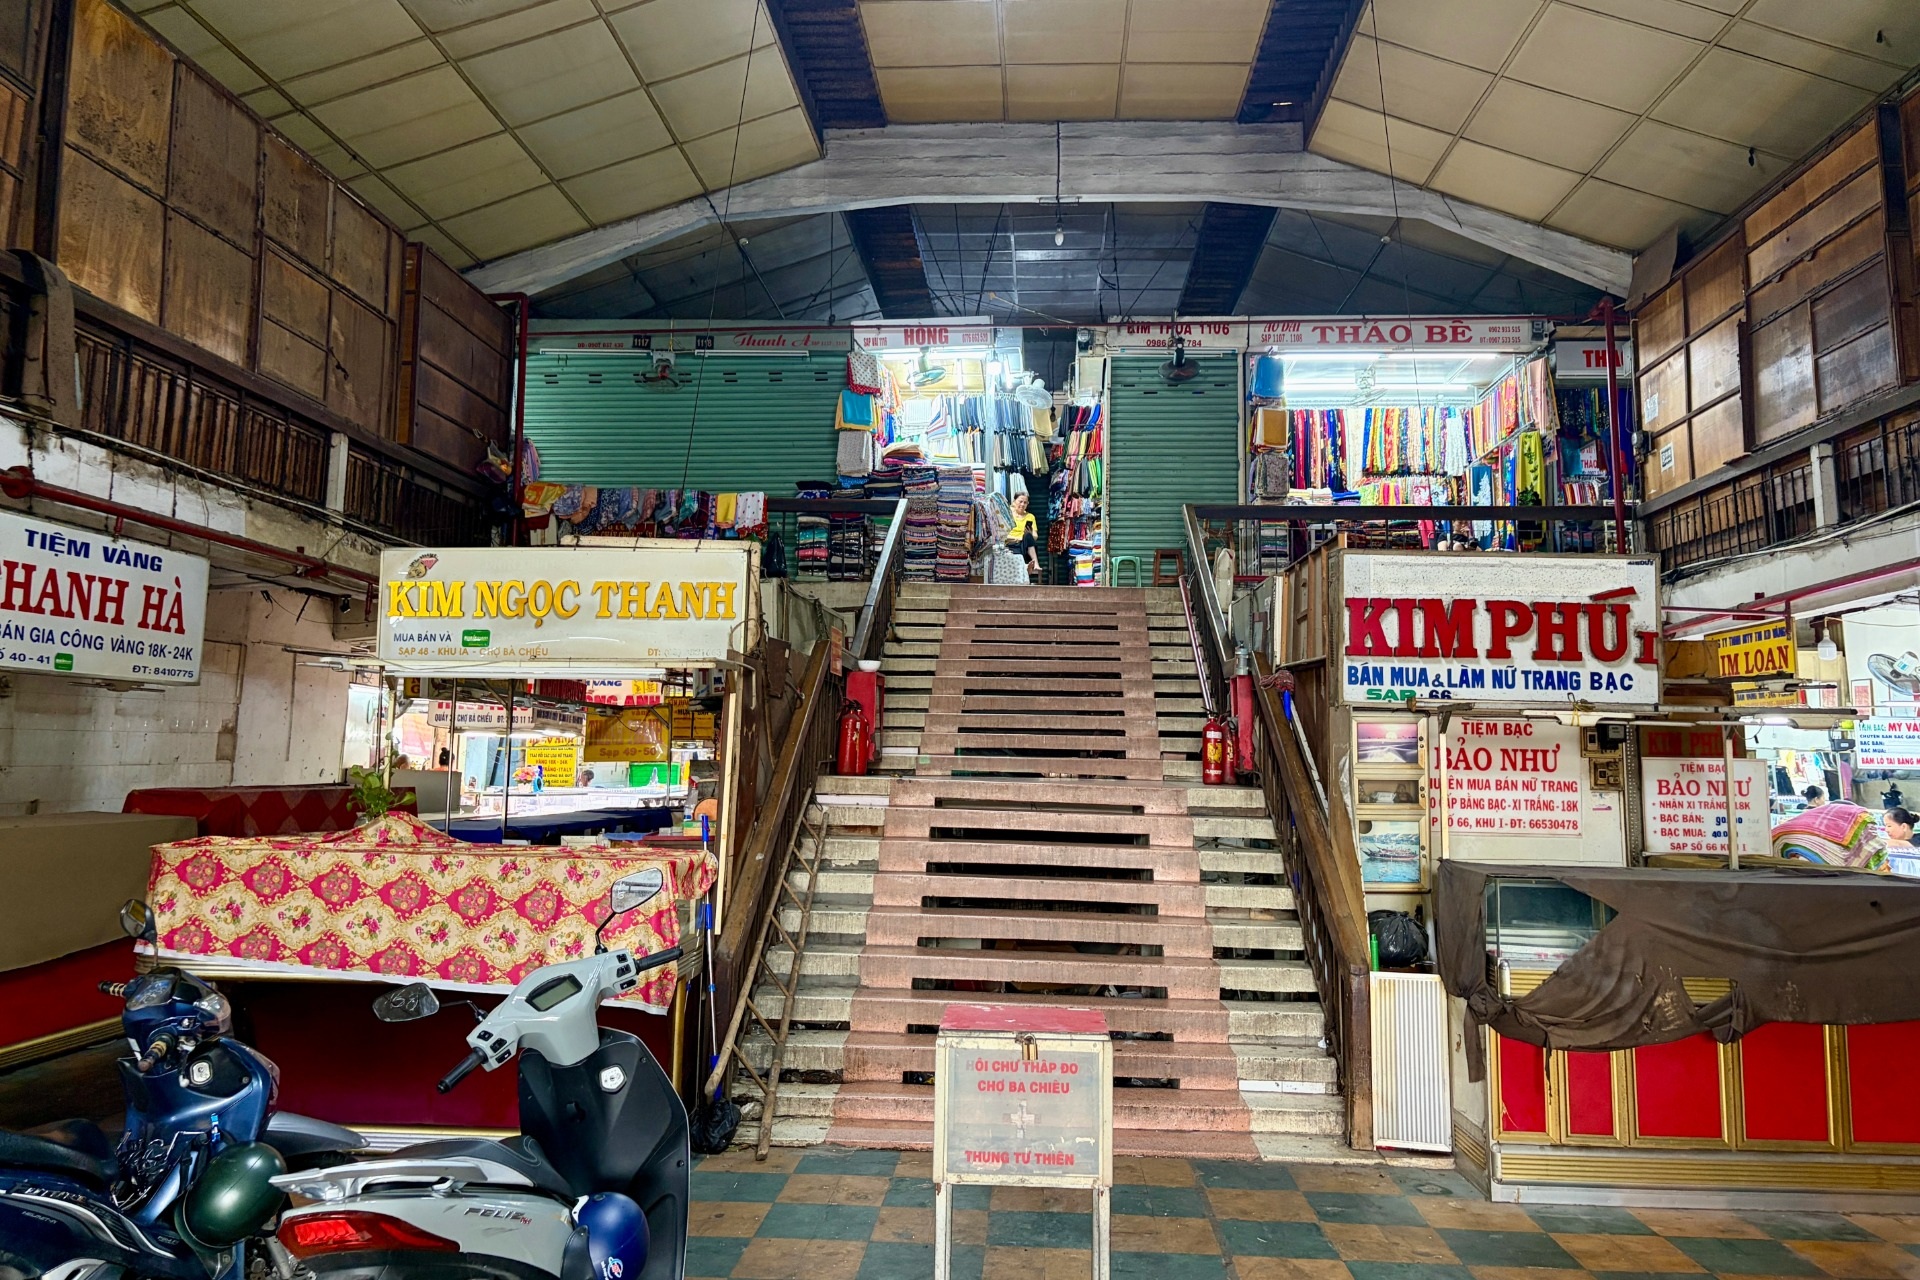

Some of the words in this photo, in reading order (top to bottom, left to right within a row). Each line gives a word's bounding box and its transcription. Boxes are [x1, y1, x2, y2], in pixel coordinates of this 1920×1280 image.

[1424, 320, 1473, 343] BÊ
[634, 338, 650, 347] 1117
[734, 332, 787, 347] Thanh
[1146, 339, 1167, 347] 0986
[1187, 339, 1202, 347] 784
[24, 528, 91, 559] TIỆM
[102, 543, 163, 573] VÀNG
[0, 560, 130, 626] HANH
[137, 575, 186, 635] HÀ
[386, 580, 466, 618] KIM
[474, 579, 582, 628] NGỌC
[591, 580, 737, 619] THANH
[1345, 597, 1479, 658] KIM
[1486, 586, 1637, 662] PHÚ
[30, 627, 56, 645] GIA
[60, 629, 105, 651] CÔNG
[110, 635, 145, 656] VÀNG
[393, 632, 415, 643] MUA
[417, 630, 437, 642] BÁN
[439, 630, 452, 642] VÀ
[9, 652, 27, 663] 40
[36, 654, 51, 664] 41
[437, 646, 457, 656] KHU
[1720, 653, 1741, 677] IM
[1743, 645, 1790, 674] LOAN
[132, 664, 152, 676] ĐT:
[153, 666, 195, 679] 8410775
[1347, 662, 1384, 686] BÁN
[1390, 666, 1429, 688] MUA
[1431, 672, 1444, 687] &
[1447, 664, 1485, 689] LÀM
[1492, 664, 1517, 690] NỮ
[1521, 670, 1581, 691] TRANG
[1589, 671, 1634, 694] BẠC
[1428, 688, 1452, 700] 66
[1461, 720, 1498, 737] TIỆM
[1503, 722, 1533, 738] BẠC
[1434, 737, 1493, 772] BẢO
[1500, 743, 1561, 772] NHƯ
[1680, 762, 1705, 774] TIỆM
[1467, 779, 1491, 791] MUA
[1495, 776, 1518, 792] BÁN
[1521, 776, 1538, 792] NỮ
[1541, 780, 1578, 793] TRANG
[1657, 772, 1701, 796] BẢO
[1460, 792, 1485, 811] BẰNG
[1488, 798, 1507, 813] BẠC
[1523, 794, 1555, 811] TRẮNG
[1561, 800, 1579, 812] 18K
[1659, 798, 1684, 811] NHẬN
[1475, 817, 1496, 829] KHU
[1510, 818, 1526, 829] ĐT:
[1529, 818, 1579, 830] 66530478
[1660, 814, 1680, 825] BẠC
[1682, 811, 1705, 824] BÁN:
[1660, 828, 1680, 840] BẠC
[1682, 828, 1706, 838] MUA:
[1670, 842, 1689, 853] SẠP
[1690, 840, 1703, 852] SỐ
[1705, 843, 1718, 852] 66
[463, 1207, 526, 1220] FELIZ
